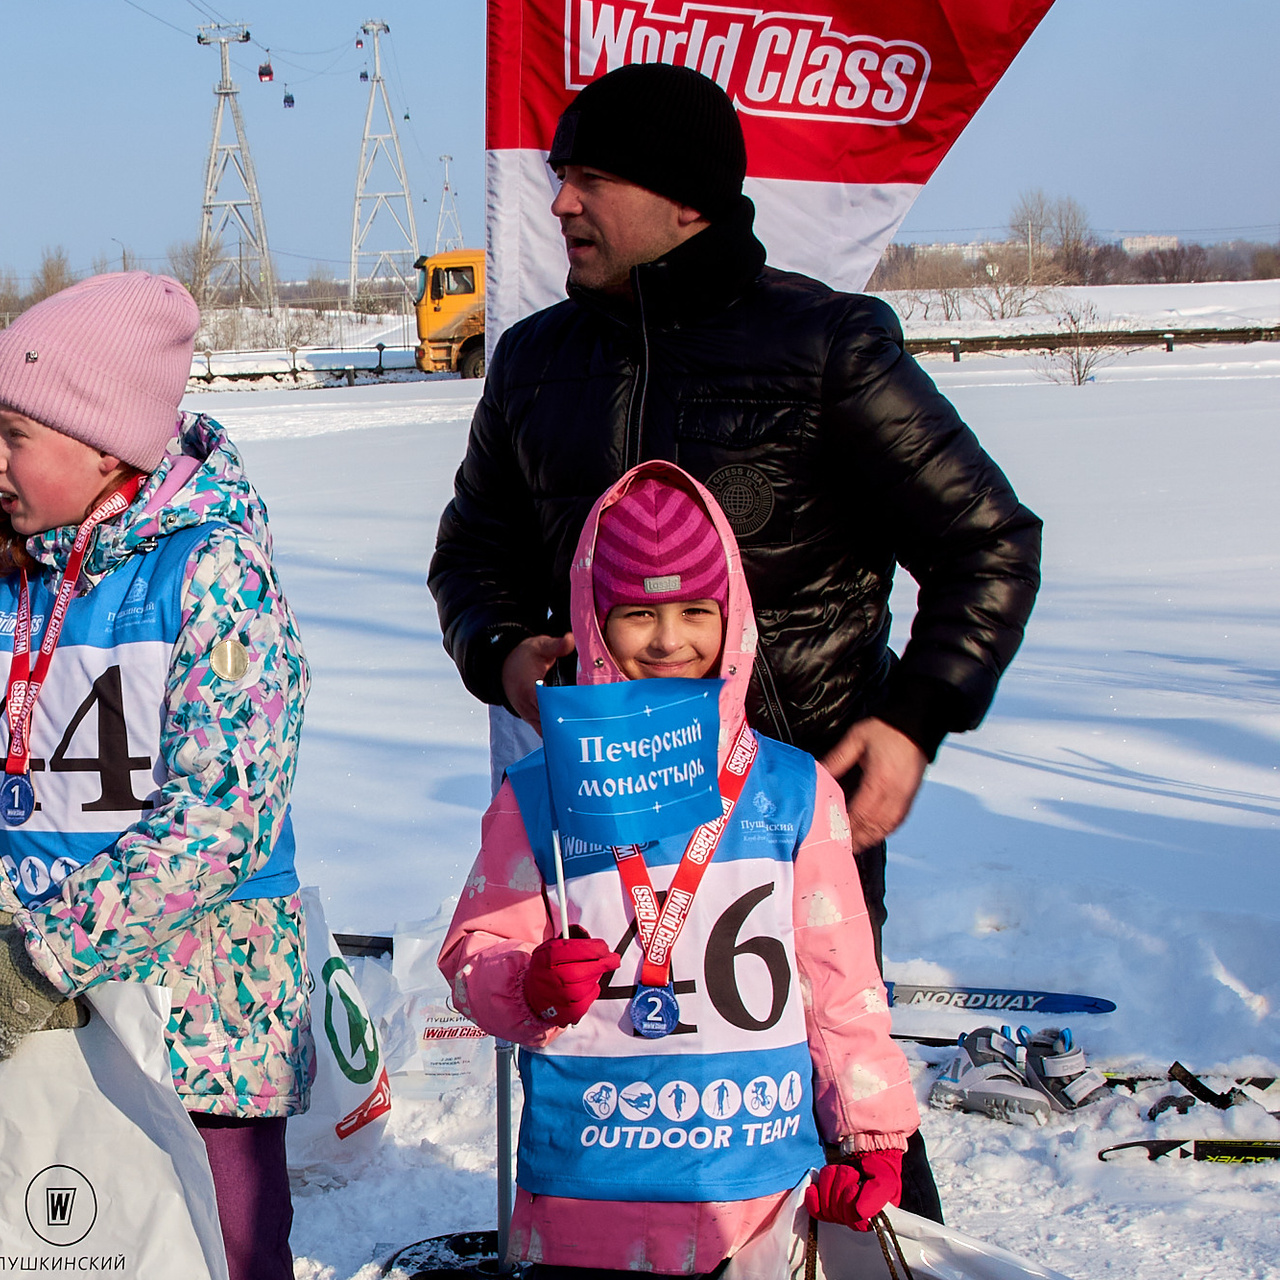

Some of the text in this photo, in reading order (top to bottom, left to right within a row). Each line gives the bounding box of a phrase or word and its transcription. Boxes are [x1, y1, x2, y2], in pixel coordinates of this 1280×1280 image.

[745, 24, 920, 114] Class
[746, 469, 764, 486] USA
[43, 581, 73, 653] World Class
[578, 718, 703, 763] Печерский
[729, 746, 752, 773] Class
[577, 757, 705, 798] монастырь
[10, 785, 19, 809] 1
[690, 827, 716, 862] Class
[662, 891, 690, 934] World
[650, 927, 675, 962] Class
[646, 997, 663, 1022] 2
[910, 990, 1045, 1010] NORDWAY
[425, 1027, 458, 1039] World
[580, 1114, 801, 1149] OUTDOOR TEAM
[50, 1193, 70, 1221] W
